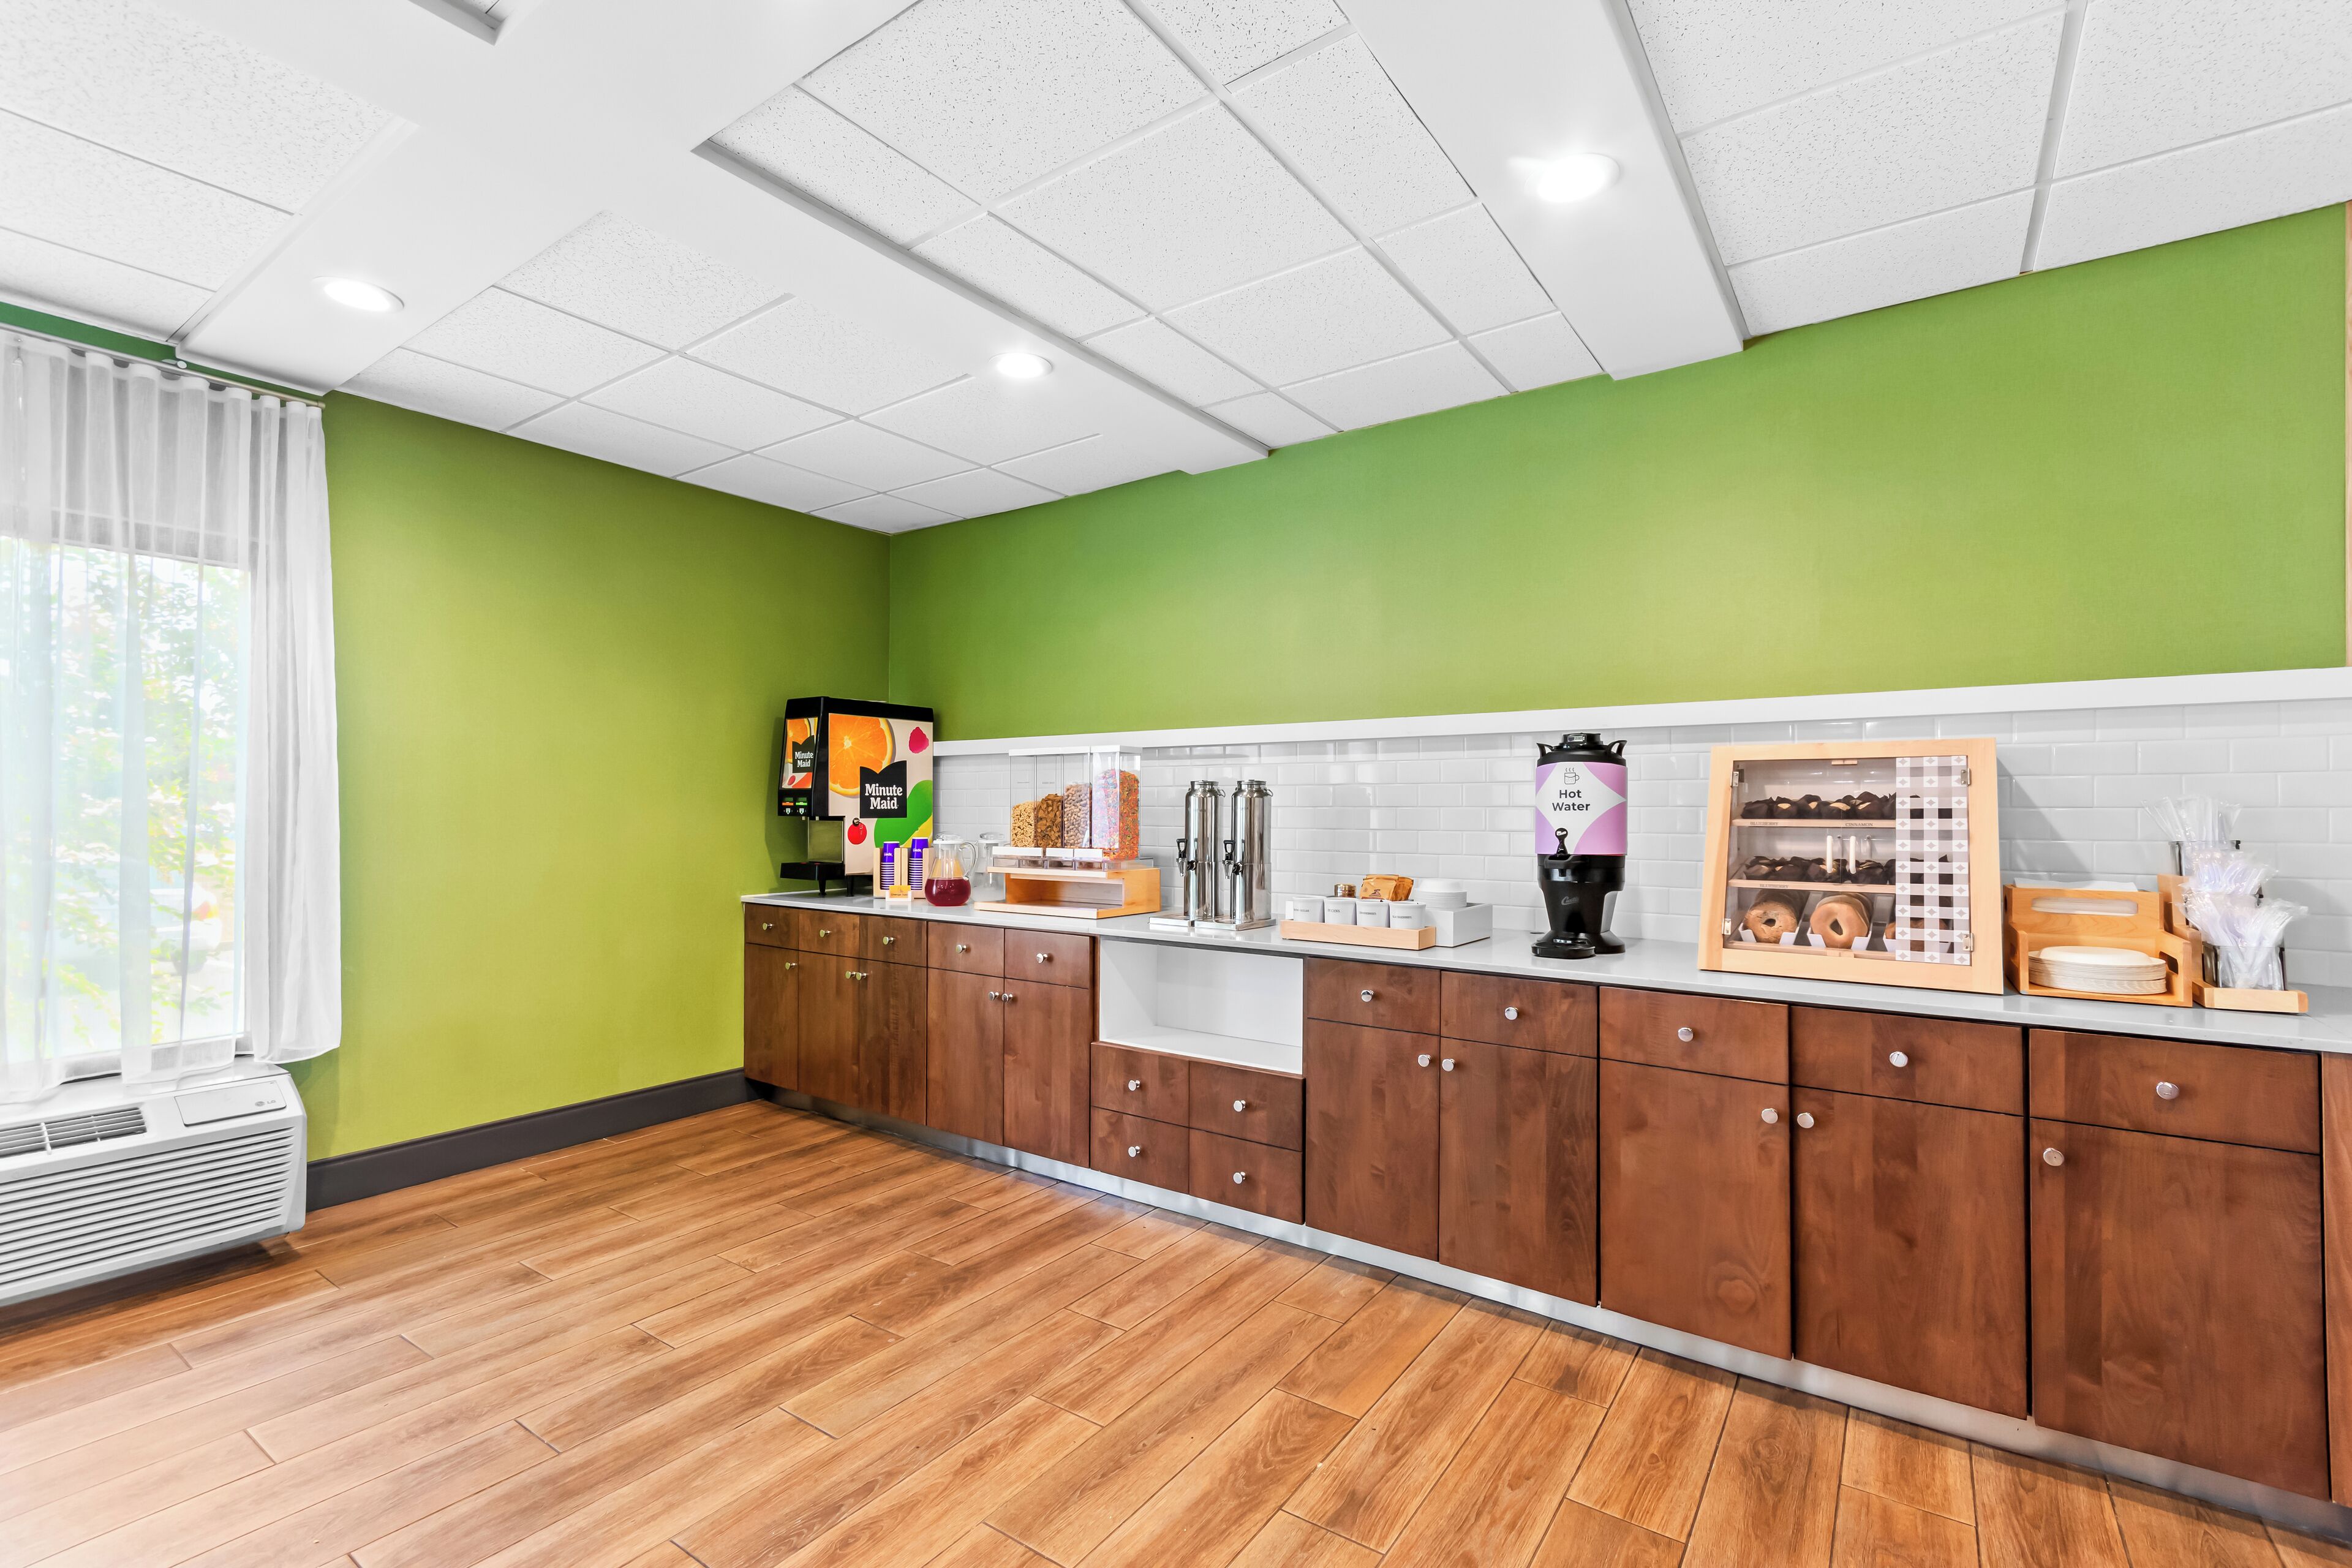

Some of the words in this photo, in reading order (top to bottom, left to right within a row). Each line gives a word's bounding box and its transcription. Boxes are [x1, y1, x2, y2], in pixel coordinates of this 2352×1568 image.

[795, 751, 813, 760] Minute
[865, 783, 903, 796] Minute
[1559, 790, 1582, 799] Hot
[870, 797, 898, 809] Maid
[1552, 802, 1591, 812] Water
